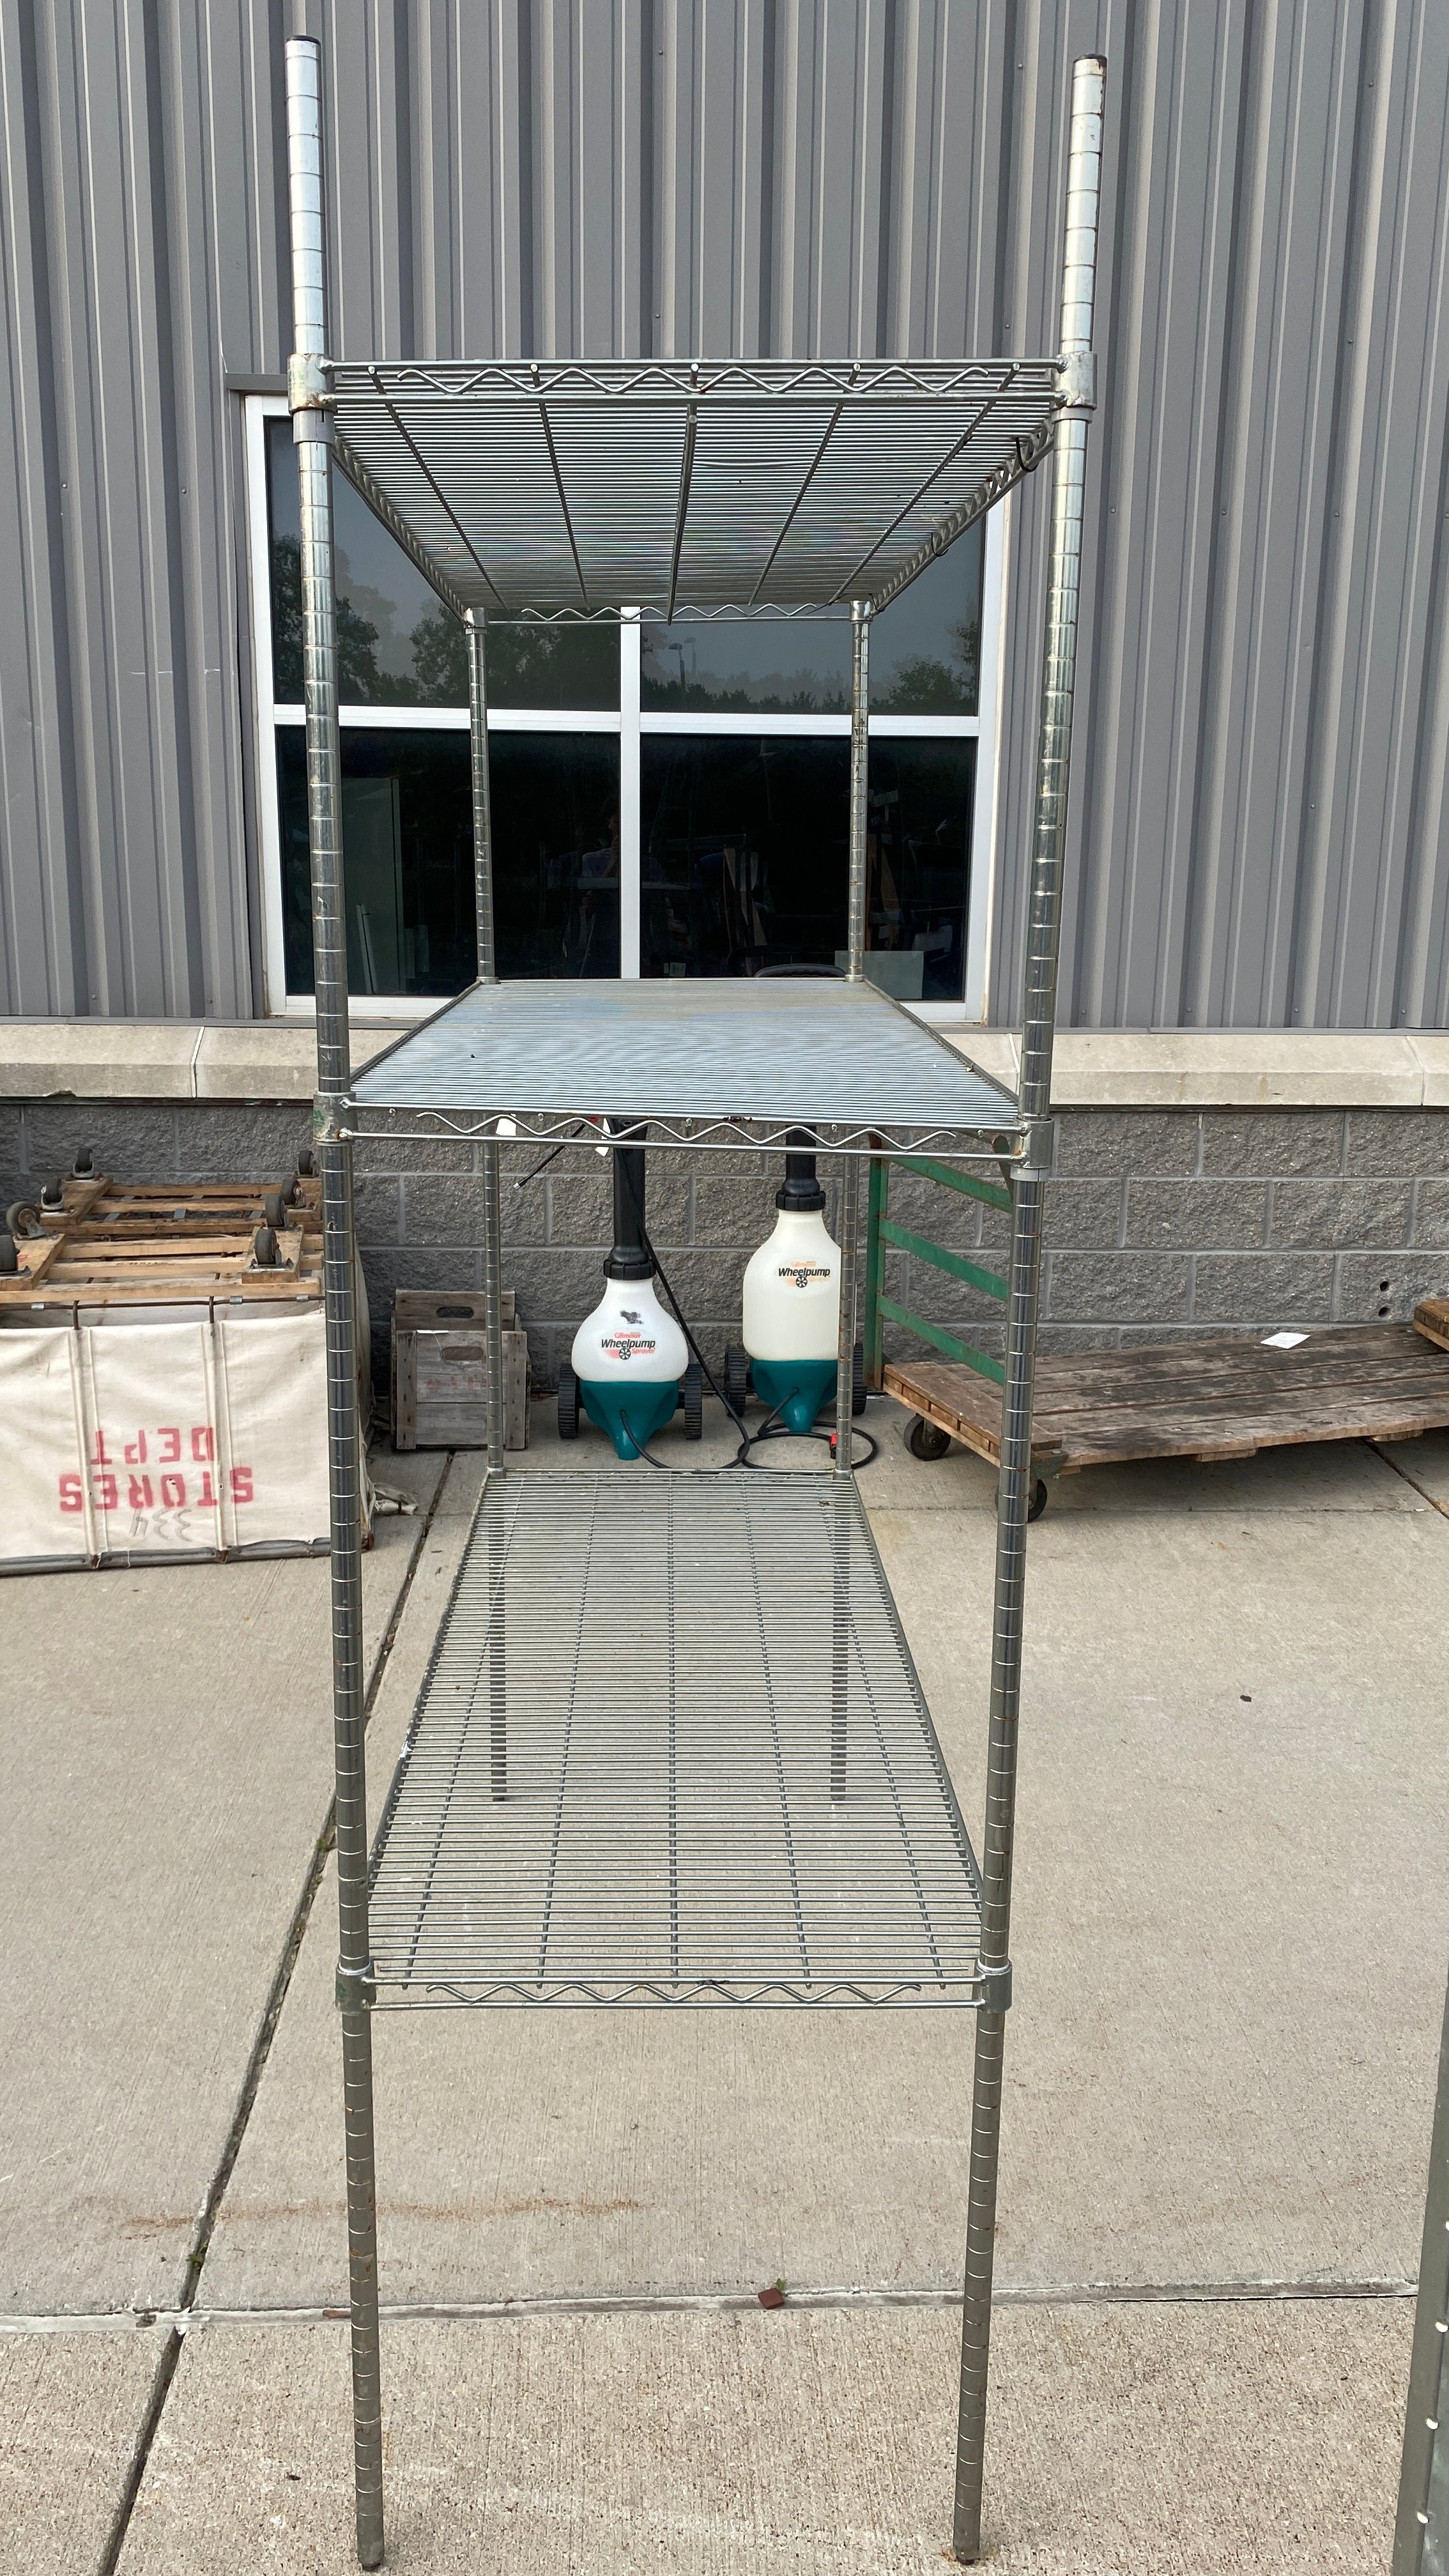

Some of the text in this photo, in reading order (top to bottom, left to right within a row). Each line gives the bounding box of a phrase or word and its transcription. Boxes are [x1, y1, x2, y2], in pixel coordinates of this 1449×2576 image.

[778, 1267, 831, 1278] Wheelpump
[601, 1339, 656, 1349] Wheelpump
[91, 1427, 214, 1464] DEPT
[59, 1468, 254, 1512] STORES
